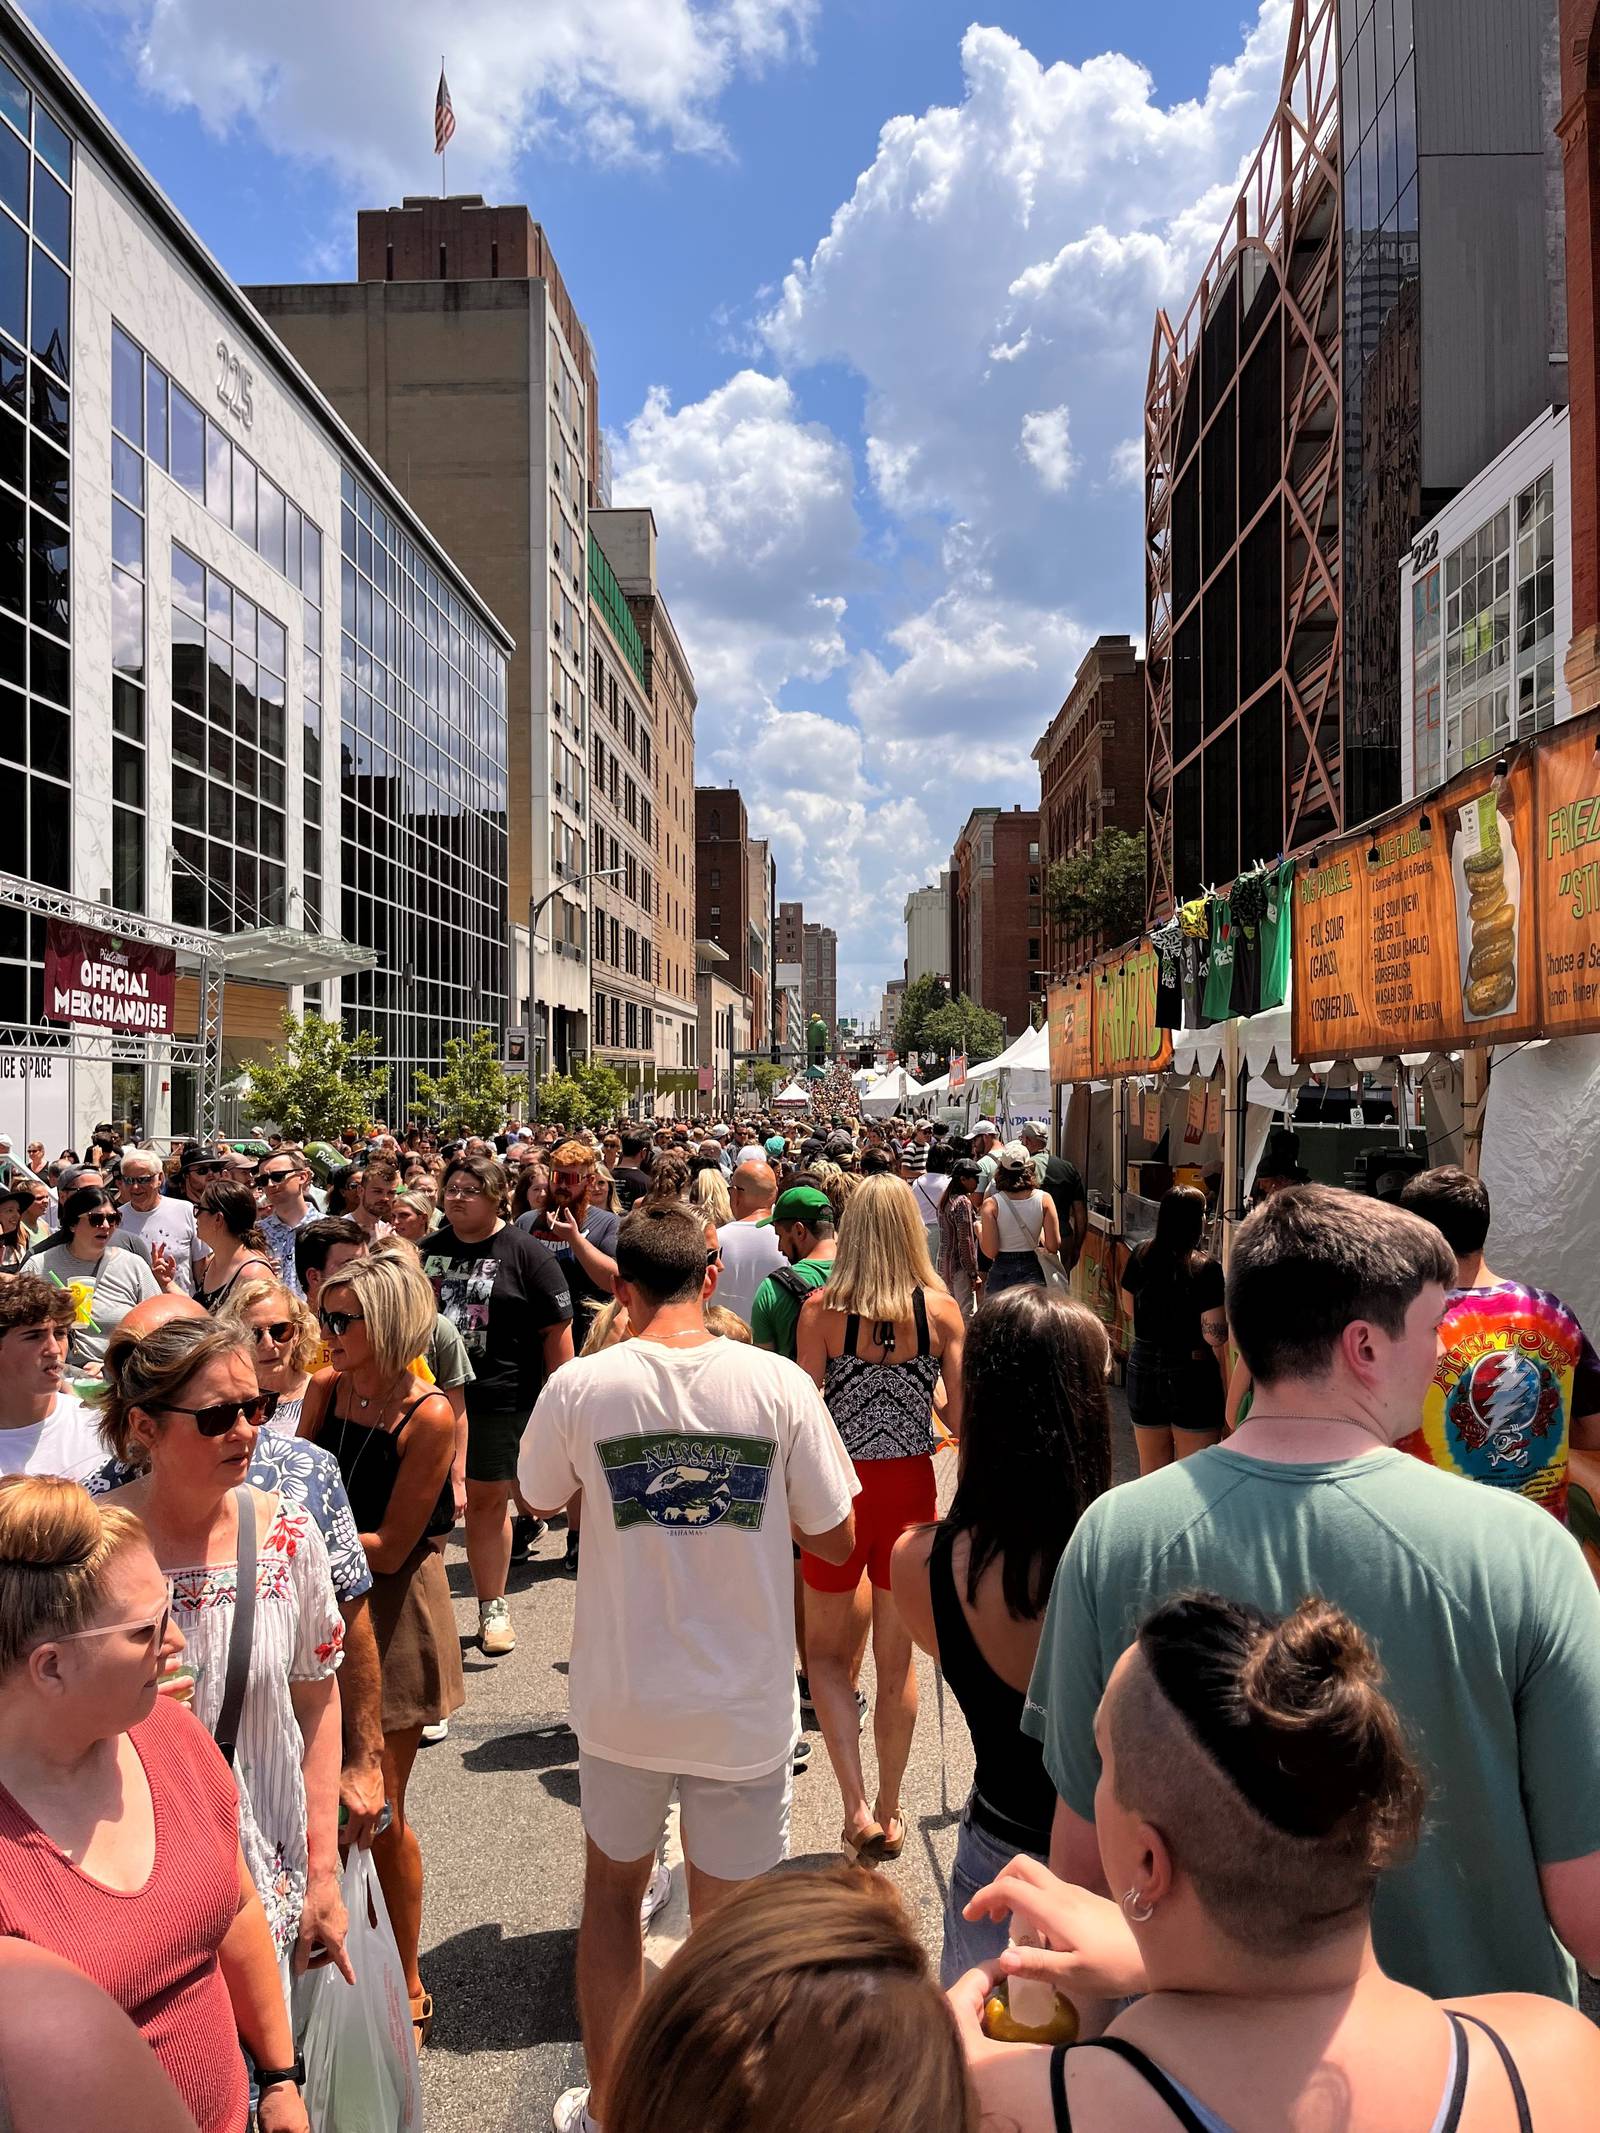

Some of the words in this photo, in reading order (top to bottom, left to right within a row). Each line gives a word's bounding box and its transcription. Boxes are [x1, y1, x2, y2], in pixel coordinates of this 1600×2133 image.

[216, 341, 253, 431] 225
[1412, 529, 1439, 576] 222
[1302, 878, 1315, 905] BIG
[1318, 860, 1352, 899] PICKLE
[1325, 915, 1344, 944] SOUR
[80, 959, 150, 998] OFFICIAL
[1577, 951, 1585, 970] a
[54, 986, 167, 1029] MERCHANDISE
[1311, 995, 1341, 1022] KOSHER
[0, 1056, 16, 1079] ICE
[20, 1056, 52, 1079] SPACE
[1432, 1331, 1495, 1398] FINAL
[1495, 1325, 1572, 1378] TOUR
[642, 1441, 742, 1473] NASSAU
